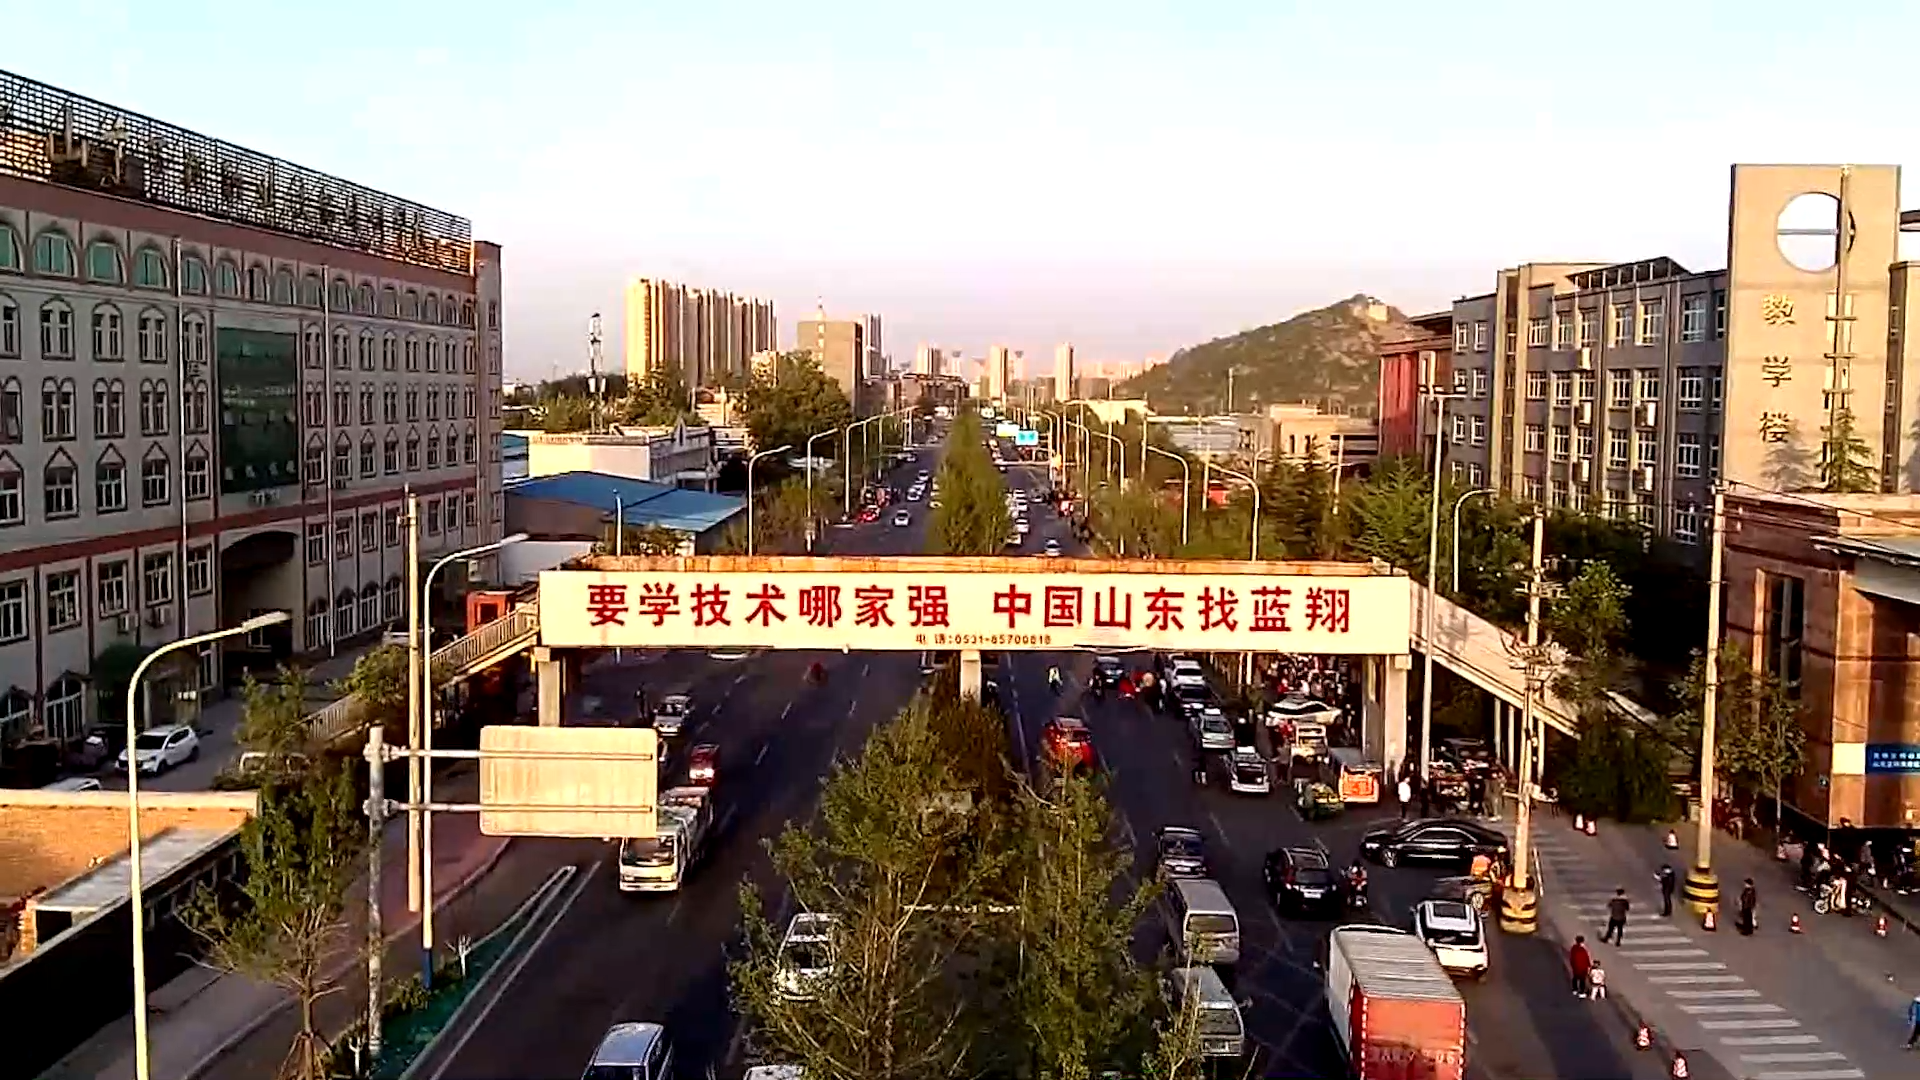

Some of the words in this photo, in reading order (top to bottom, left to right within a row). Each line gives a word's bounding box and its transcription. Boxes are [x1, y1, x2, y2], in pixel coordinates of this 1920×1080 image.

[586, 583, 949, 628] 要学技术哪家强
[993, 584, 1349, 632] 中国山东找蓝翔
